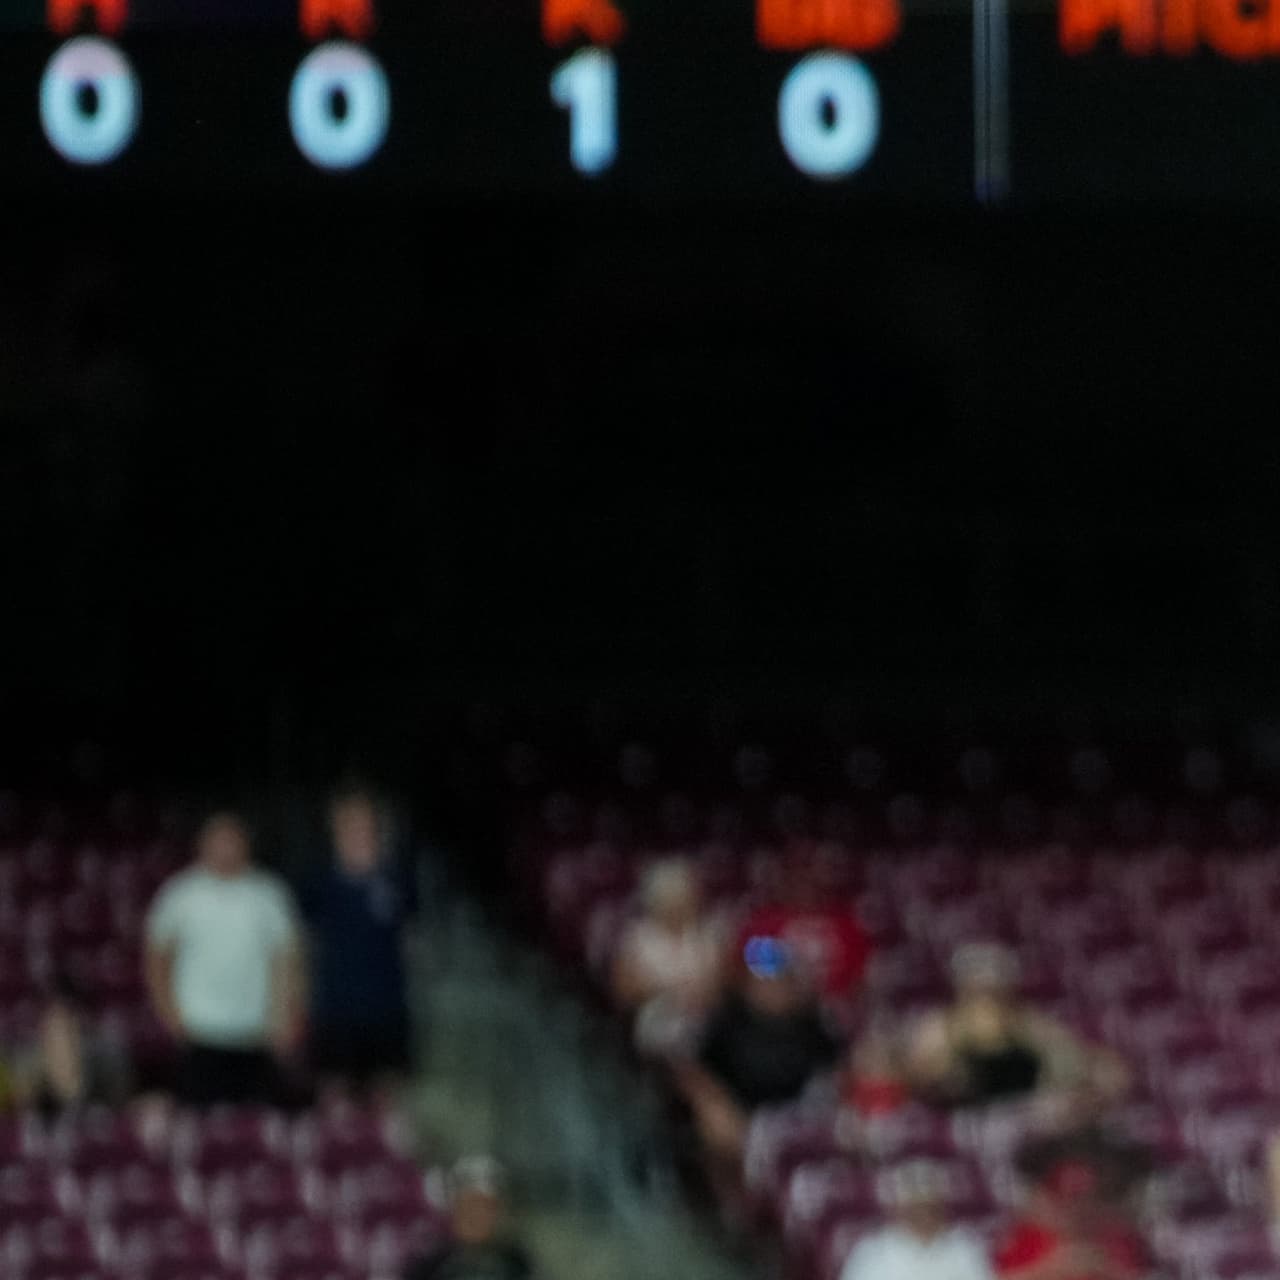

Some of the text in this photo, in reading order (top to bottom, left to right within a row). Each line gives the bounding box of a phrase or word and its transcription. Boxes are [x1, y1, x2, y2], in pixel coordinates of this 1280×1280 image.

[40, 36, 881, 178] 0 0 1 0
